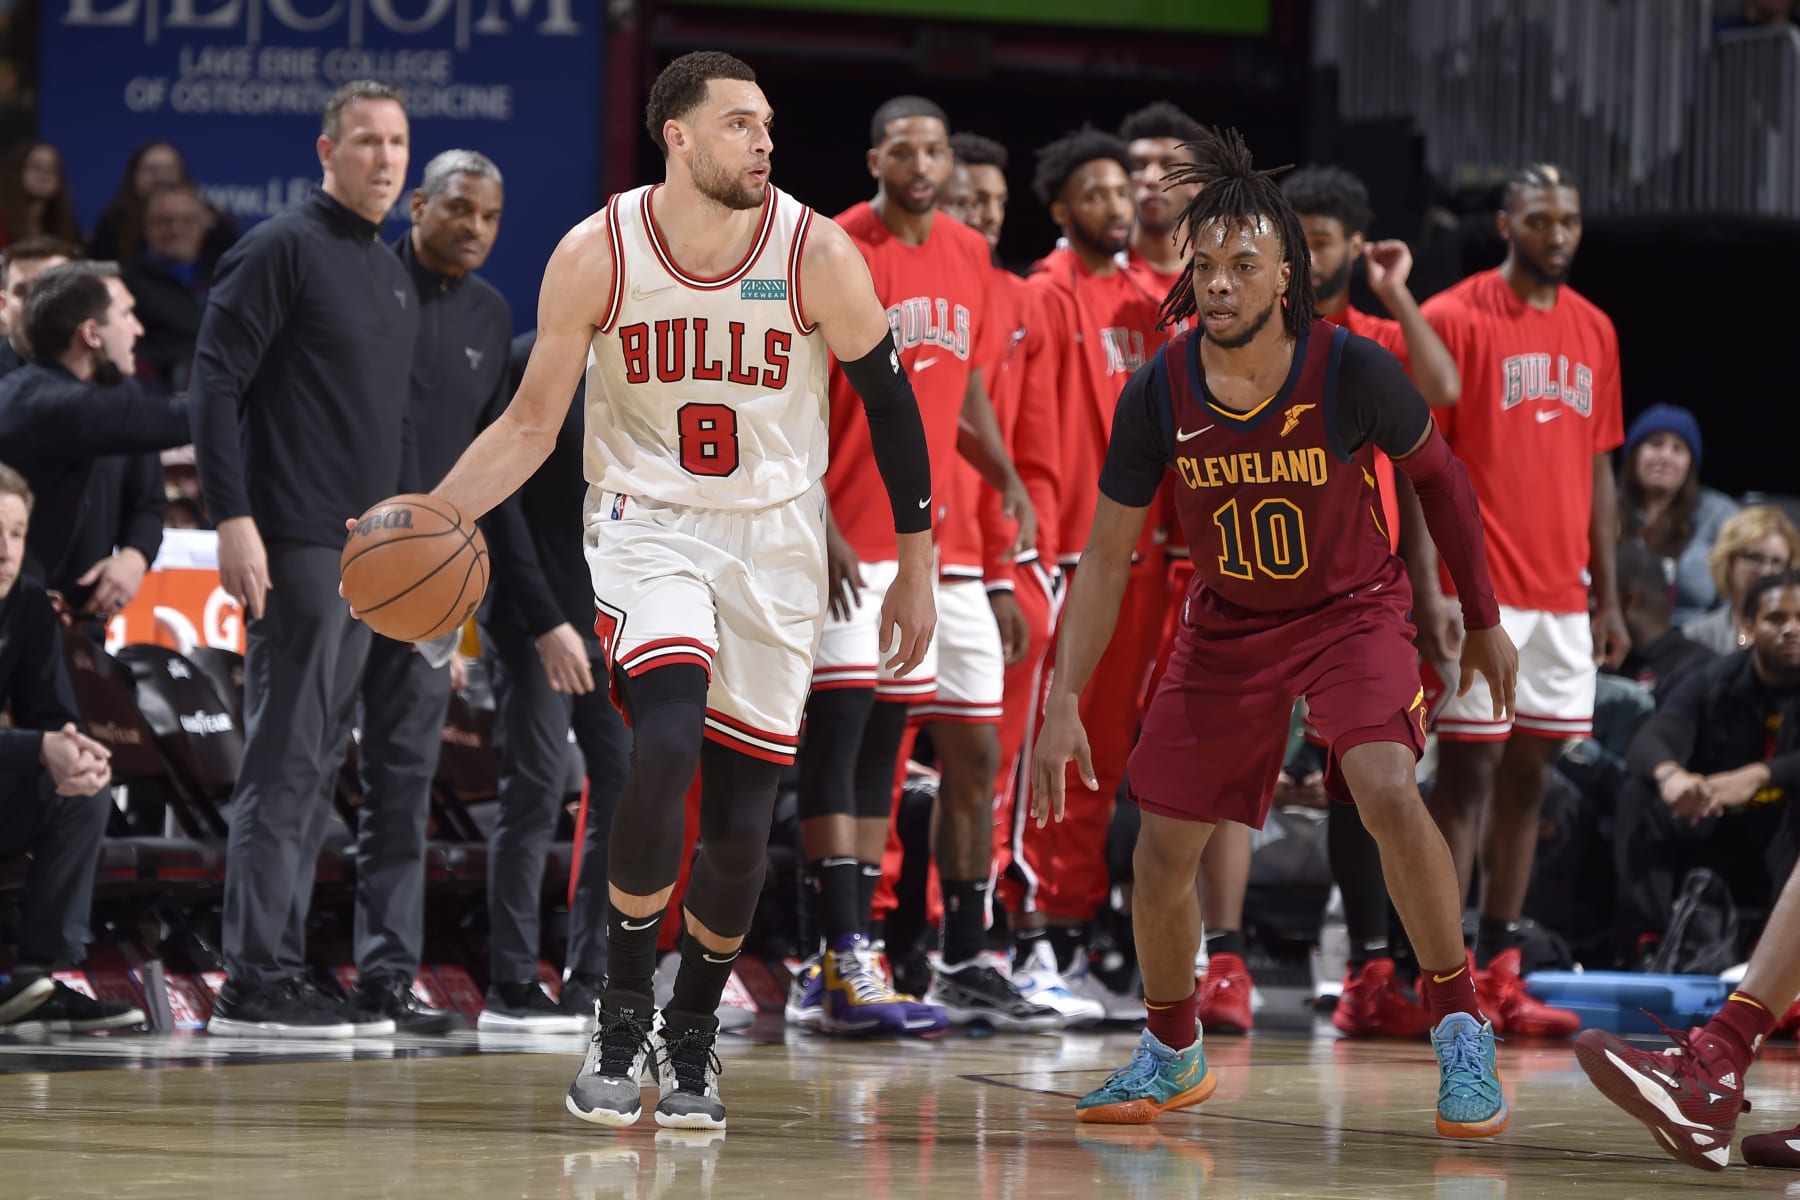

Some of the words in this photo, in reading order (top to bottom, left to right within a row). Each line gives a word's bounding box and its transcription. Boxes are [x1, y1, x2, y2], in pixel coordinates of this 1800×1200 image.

[125, 77, 166, 113] OF
[179, 46, 253, 81] LAKE
[258, 48, 321, 81] ERIE
[323, 50, 450, 83] COLLEGE
[742, 281, 786, 290] ZENNI
[618, 317, 792, 390] BULLS
[885, 296, 970, 361] BULLS
[1501, 352, 1593, 418] BULLS
[677, 402, 740, 477] 8
[1177, 447, 1328, 490] CLEVELAND
[1213, 497, 1309, 581] 10
